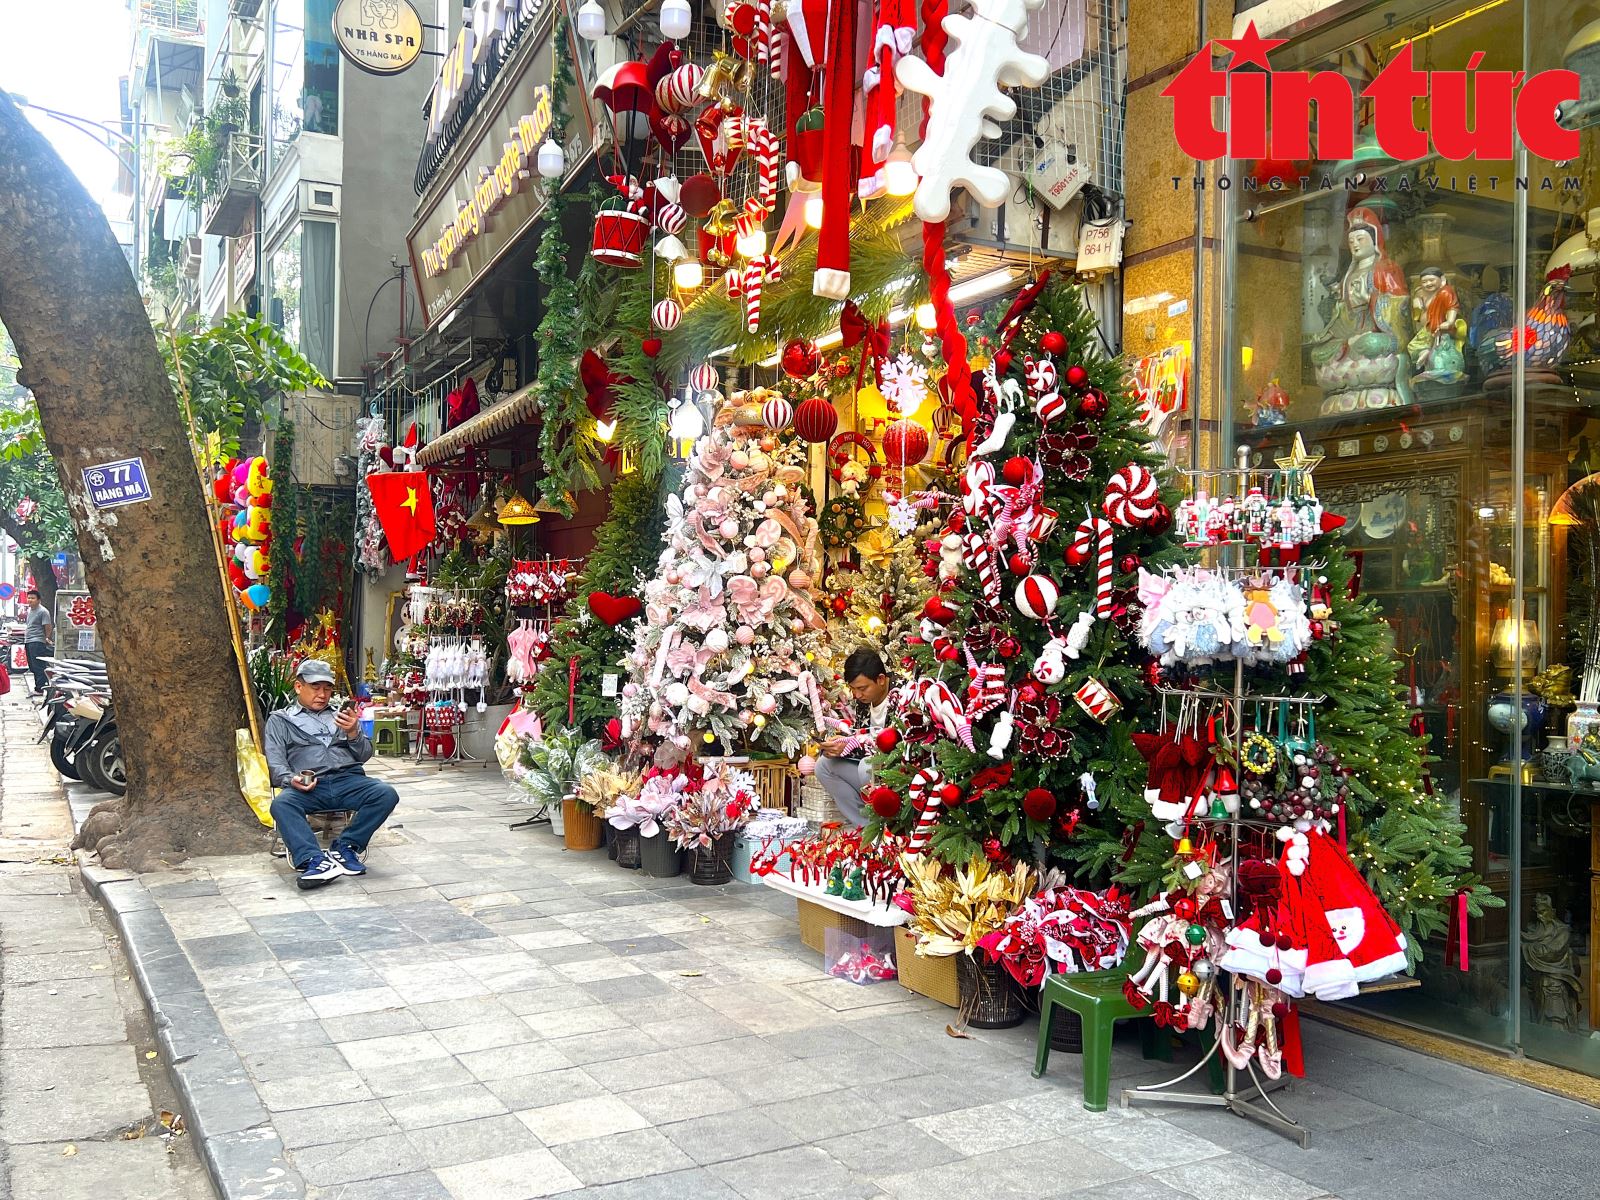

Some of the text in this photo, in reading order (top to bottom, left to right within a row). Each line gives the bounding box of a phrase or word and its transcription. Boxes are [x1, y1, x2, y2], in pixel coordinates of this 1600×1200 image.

[344, 27, 415, 47] NHÀ SPA
[355, 48, 365, 56] 75
[1086, 228, 1109, 240] P756
[1085, 242, 1111, 255] 664 H
[843, 433, 855, 441] HO!
[861, 438, 872, 449] HO!
[109, 465, 131, 483] 77
[95, 482, 143, 502] HÀNG MÃ
